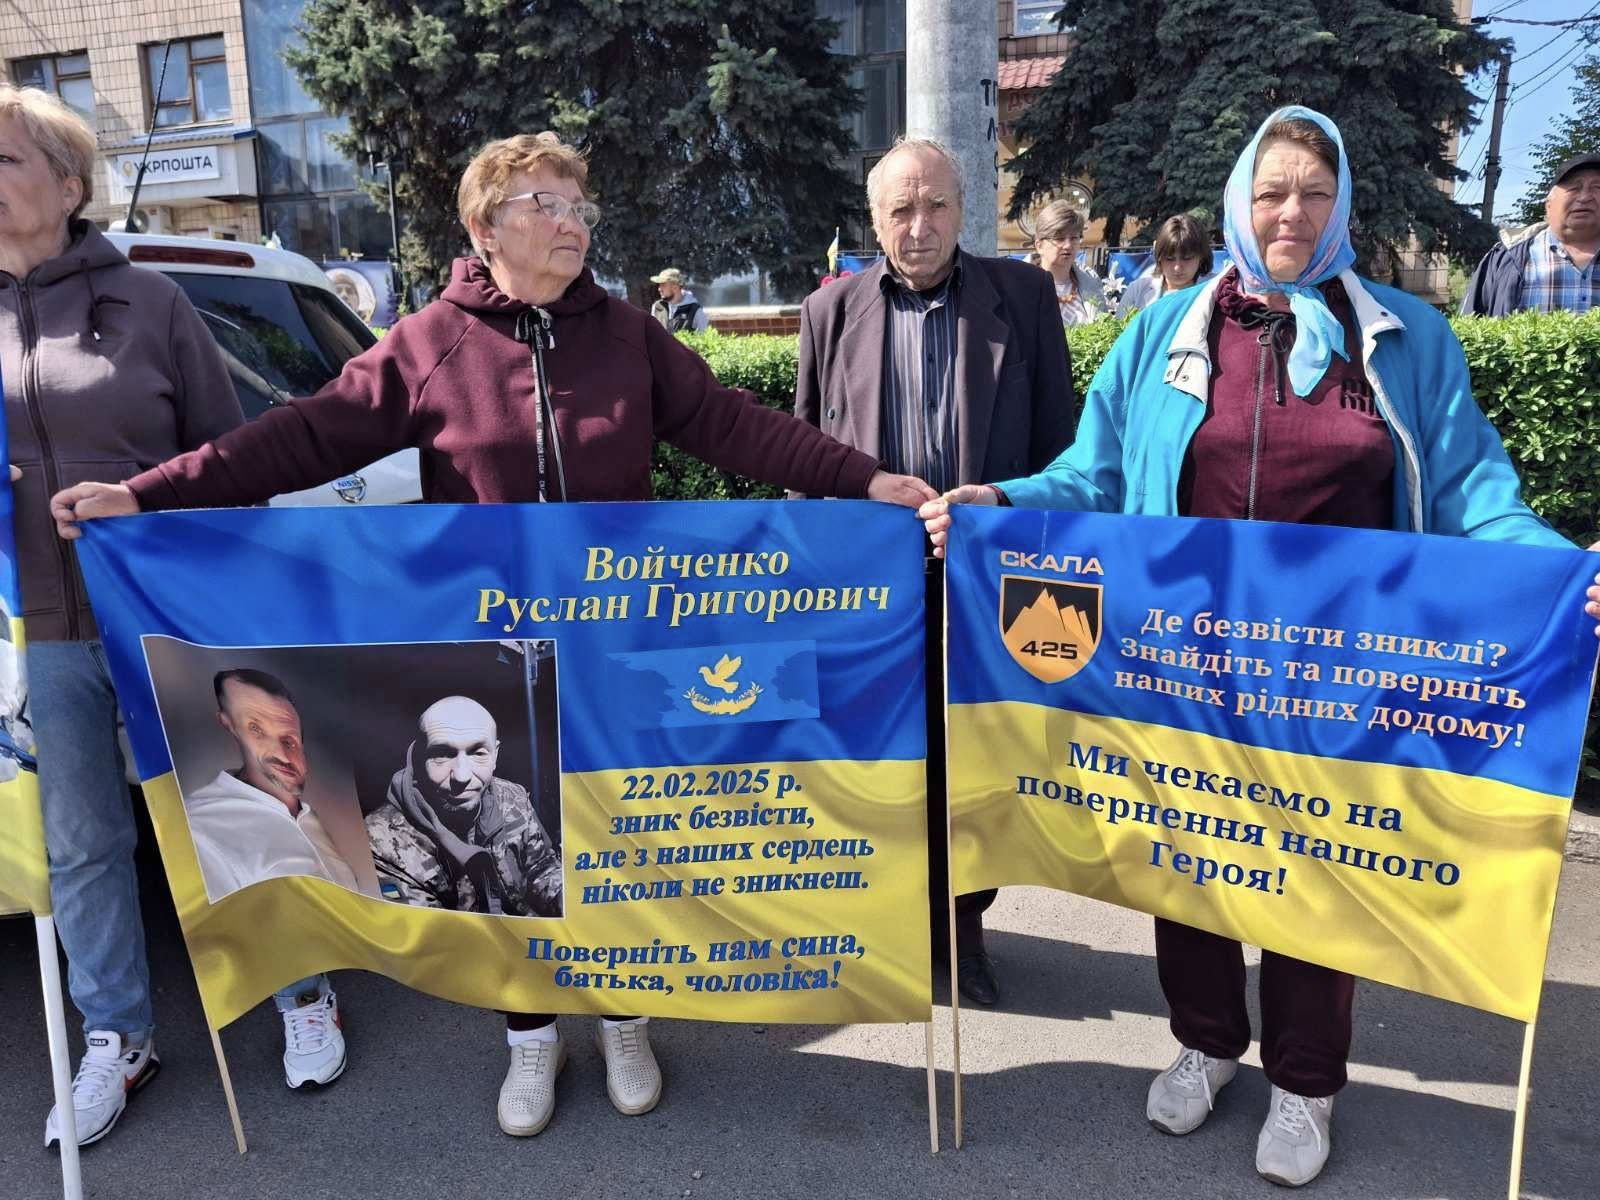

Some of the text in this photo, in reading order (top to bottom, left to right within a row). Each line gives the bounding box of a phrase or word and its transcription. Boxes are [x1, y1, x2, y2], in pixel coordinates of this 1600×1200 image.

[134, 156, 213, 174] УКРПОШТА
[584, 546, 790, 582] Войченко
[1000, 550, 1104, 575] СКАЛА
[474, 583, 891, 632] Руслан Григорович
[1020, 640, 1078, 660] 425
[1141, 608, 1508, 668] Де безвісти зниклі?
[1120, 637, 1527, 710] Знайдіть та поверніть
[1114, 667, 1526, 749] наших рідних додому!
[620, 769, 802, 800] 22.02.2025 р.
[1066, 741, 1402, 832] Ми чекаємо на
[609, 804, 815, 835] зник безвісти,
[1016, 775, 1460, 887] повернення нашого
[575, 836, 874, 871] але з наших сердець
[1149, 841, 1287, 896] Героя!
[581, 868, 869, 904] ніколи не зникнеш.
[526, 934, 865, 969] Поверніть нам сина,
[554, 960, 841, 995] батька, чоловіка!
